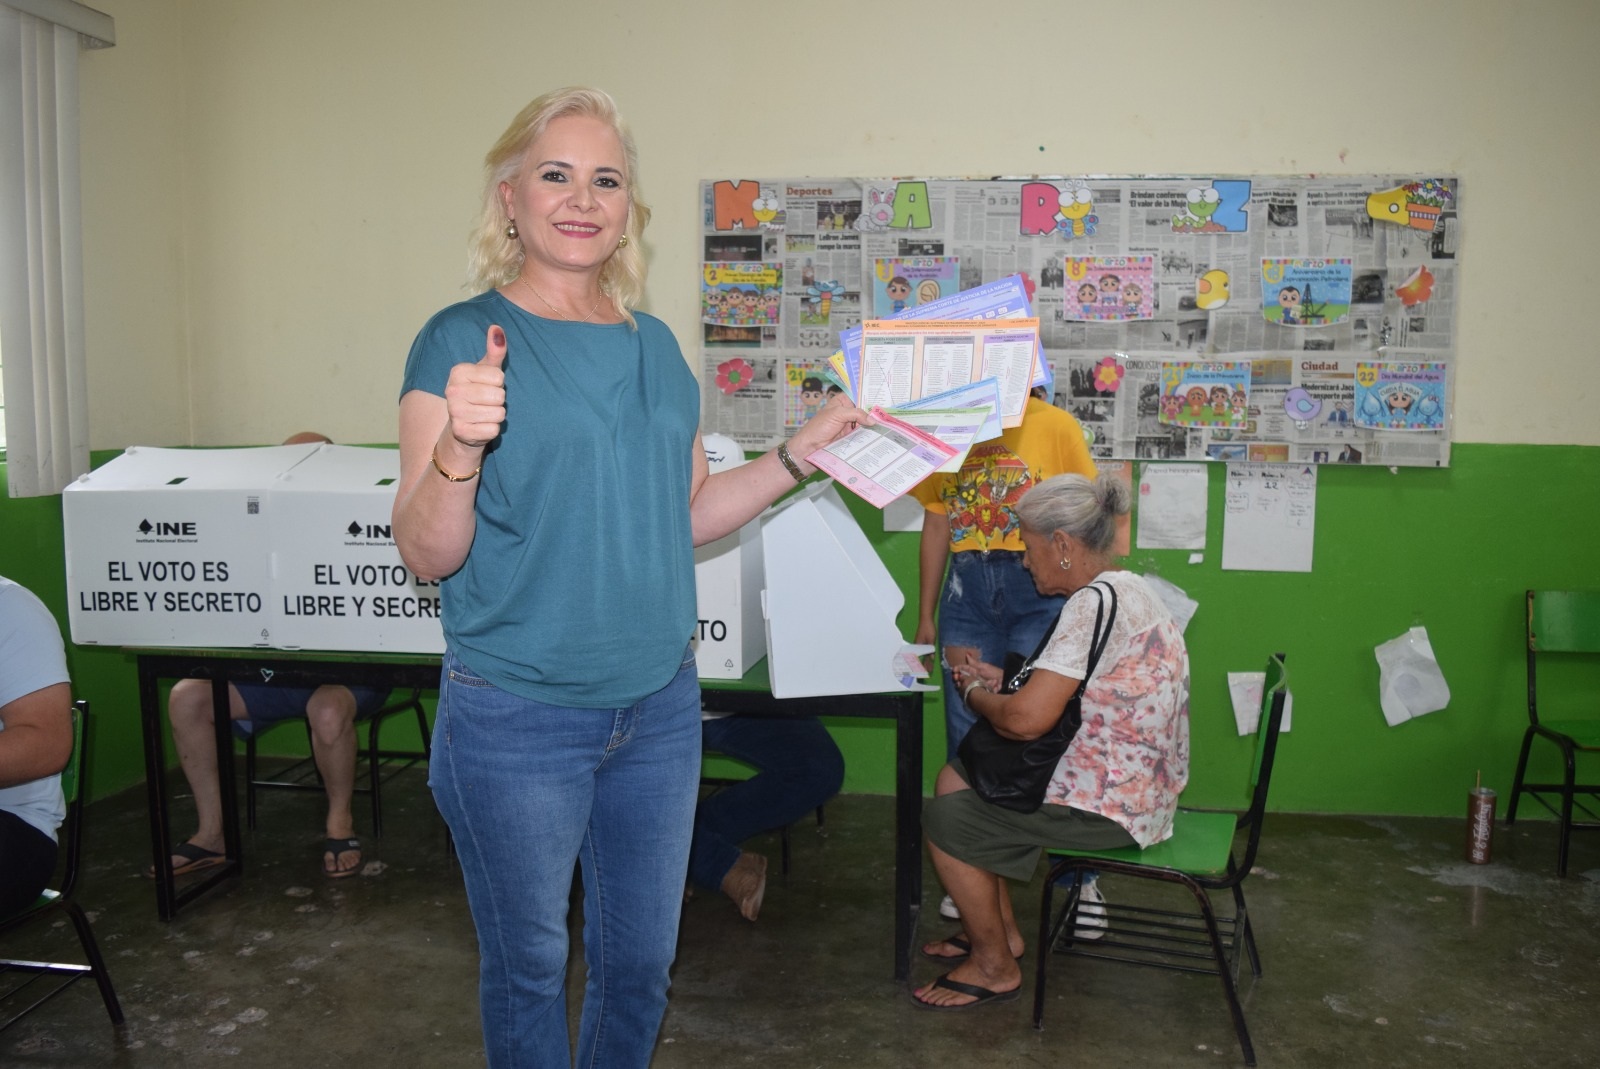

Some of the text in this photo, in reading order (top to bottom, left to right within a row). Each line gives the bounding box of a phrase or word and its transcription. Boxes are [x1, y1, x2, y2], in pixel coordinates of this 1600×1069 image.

[786, 187, 833, 198] Deportes
[1130, 191, 1151, 199] Brindan
[713, 179, 760, 231] M
[888, 181, 932, 229] A
[1020, 182, 1061, 236] R
[1211, 181, 1251, 232] Z
[1137, 200, 1154, 208] valor
[818, 234, 860, 242] LeBron James
[817, 244, 836, 252] rompe
[1072, 262, 1080, 276] 8
[1267, 265, 1281, 281] 18
[708, 269, 718, 282] 2
[915, 304, 938, 316] SUPREMA
[938, 299, 953, 309] CORTE
[960, 291, 980, 302] JUSTICIA
[994, 281, 1013, 292] NACIÓN
[1301, 361, 1338, 371] Ciudad
[788, 370, 804, 381] 21
[1359, 371, 1375, 382] 22
[1423, 373, 1439, 381] Agua
[1301, 383, 1339, 391] Modernizará
[1309, 393, 1340, 401] ransporte
[1168, 466, 1201, 476] hexagonal
[156, 522, 197, 536] INE
[108, 561, 229, 582] EL VOTO ES
[314, 564, 340, 586] EL
[346, 564, 408, 587] VOTO
[80, 591, 262, 613] LIBRE Y SECRETO
[284, 595, 441, 618] LIBRE Y SECRE
[690, 619, 727, 642] TO
